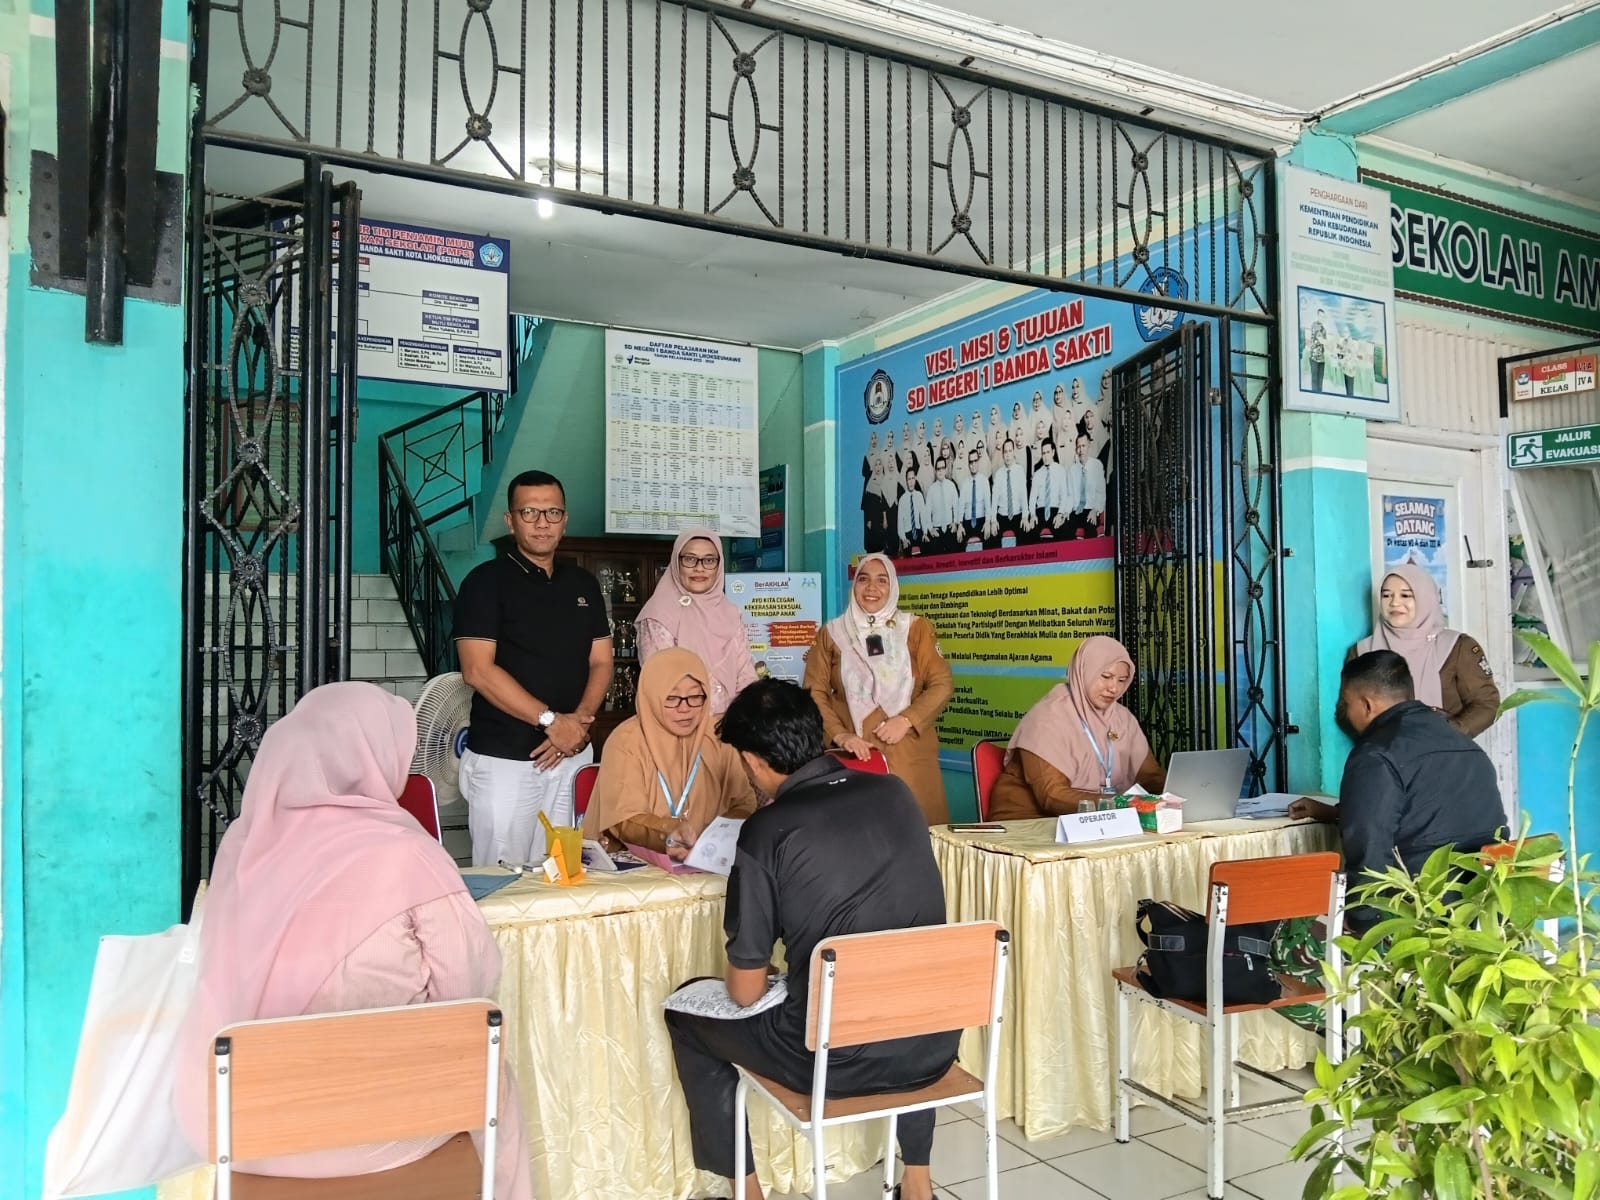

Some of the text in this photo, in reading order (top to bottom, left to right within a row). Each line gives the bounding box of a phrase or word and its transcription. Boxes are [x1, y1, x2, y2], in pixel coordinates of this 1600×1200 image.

[1310, 187, 1368, 210] PENGHARGAAN DARI
[1299, 204, 1379, 230] KEMENTRIAN PENDIDIKAN
[1312, 217, 1368, 238] DAN KEBUDAYAAN
[372, 227, 392, 239] TIM
[393, 230, 444, 246] PENJAMIN
[446, 237, 475, 250] MUTU
[385, 237, 436, 252] SEKOLAH
[1308, 227, 1372, 249] REPUBLIK INDONESIA
[385, 247, 405, 258] SAKTI
[406, 250, 423, 261] KOTA
[424, 253, 474, 267] LHOKSEUMAWE
[1390, 204, 1543, 298] SEKOLAH
[926, 300, 1083, 377] VISI, MISI & TUJUAN
[649, 341, 672, 350] DAFTAR
[673, 344, 707, 353] PELAJARAN
[660, 348, 681, 356] BANDA
[681, 350, 698, 358] SAKTI
[907, 386, 926, 411] SD
[928, 368, 979, 406] NEGERI
[981, 365, 989, 389] 1
[992, 347, 1050, 386] BANDA
[1054, 325, 1111, 367] SAKTI
[1541, 362, 1567, 373] CLASS
[1540, 384, 1569, 394] KELAS
[1577, 376, 1586, 386] IV
[1586, 376, 1592, 384] A
[1555, 430, 1591, 443] JALUR
[1394, 501, 1436, 518] SELAMAT
[1395, 519, 1436, 537] DATANG
[920, 592, 930, 600] dan
[930, 591, 948, 601] Tenaga
[987, 588, 1004, 597] Lebih
[1005, 586, 1028, 596] Optimal
[970, 610, 997, 619] Teknologi
[998, 607, 1038, 618] Berdasarkan
[1061, 606, 1082, 616] Bakat
[1083, 605, 1097, 615] dan
[1098, 605, 1116, 614] Pote
[935, 621, 957, 629] Sekolah
[957, 621, 971, 630] Yang
[971, 619, 1004, 630] Partisipatif
[1004, 619, 1028, 629] Dengan
[1028, 618, 1066, 628] Melibatkan
[1067, 618, 1094, 627] Seluruh
[1095, 617, 1116, 627] Warg
[953, 631, 975, 640] Peserta
[975, 630, 990, 639] Didik
[991, 631, 1006, 640] Yang
[1038, 630, 1058, 639] Mulia
[1058, 630, 1072, 638] dan
[951, 652, 972, 660] Melalui
[972, 652, 1008, 662] Pengamalan
[1008, 652, 1029, 662] Ajaran
[1029, 653, 1052, 662] Agama
[980, 709, 994, 718] Yang
[1078, 811, 1118, 824] OPERATOR
